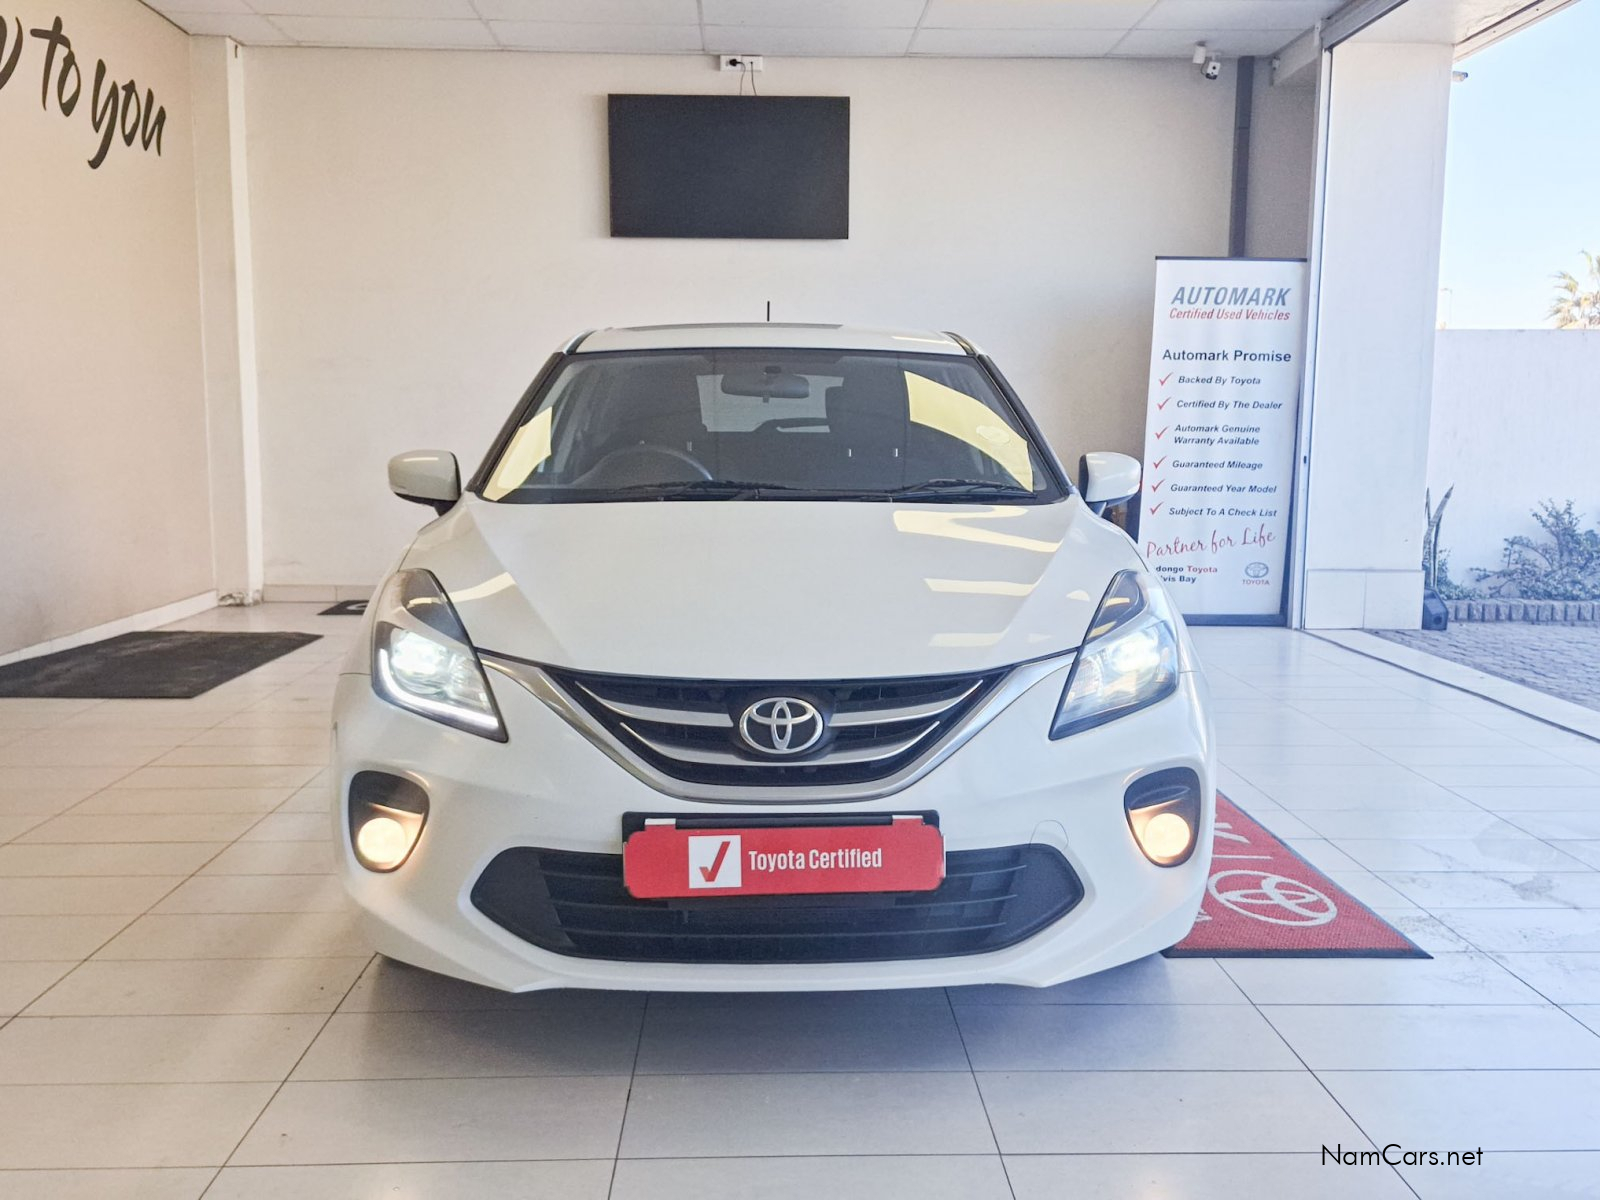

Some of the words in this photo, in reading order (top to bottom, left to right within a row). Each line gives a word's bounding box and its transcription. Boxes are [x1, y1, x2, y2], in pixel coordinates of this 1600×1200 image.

[30, 16, 81, 117] to
[88, 59, 166, 169] you
[1171, 286, 1291, 306] AUTOMARK
[1169, 308, 1213, 319] Certified
[1217, 309, 1242, 320] Used
[1245, 310, 1290, 321] Vehicles
[1162, 349, 1229, 361] Automark
[1234, 350, 1291, 362] Promise
[1178, 376, 1212, 384] Backed
[1215, 376, 1227, 386] By
[1230, 376, 1261, 386] Toyota
[1176, 400, 1216, 409] Certified
[1218, 400, 1230, 410] By
[1233, 401, 1249, 409] The
[1252, 401, 1282, 410] Dealer
[1174, 424, 1219, 433] Automark
[1221, 425, 1261, 434] Genuine
[1174, 437, 1215, 447] Warranty
[1217, 437, 1260, 446] Available
[1172, 460, 1224, 469] Guaranteed
[1227, 461, 1263, 471] Mileage
[1170, 484, 1223, 493] Guaranteed
[1226, 485, 1246, 493] Year
[1249, 485, 1277, 494] Model
[1169, 507, 1203, 517] Subject
[1206, 508, 1217, 516] To
[1218, 508, 1225, 516] A
[1227, 508, 1257, 517] Check
[1259, 508, 1277, 517] List
[1147, 537, 1207, 559] Partner
[1210, 529, 1236, 554] for
[1241, 523, 1276, 548] Life
[1155, 565, 1184, 574] dongo
[1187, 565, 1218, 574] Toyota
[1179, 576, 1196, 584] Bay
[749, 849, 806, 872] Toyota
[809, 848, 882, 868] Certified
